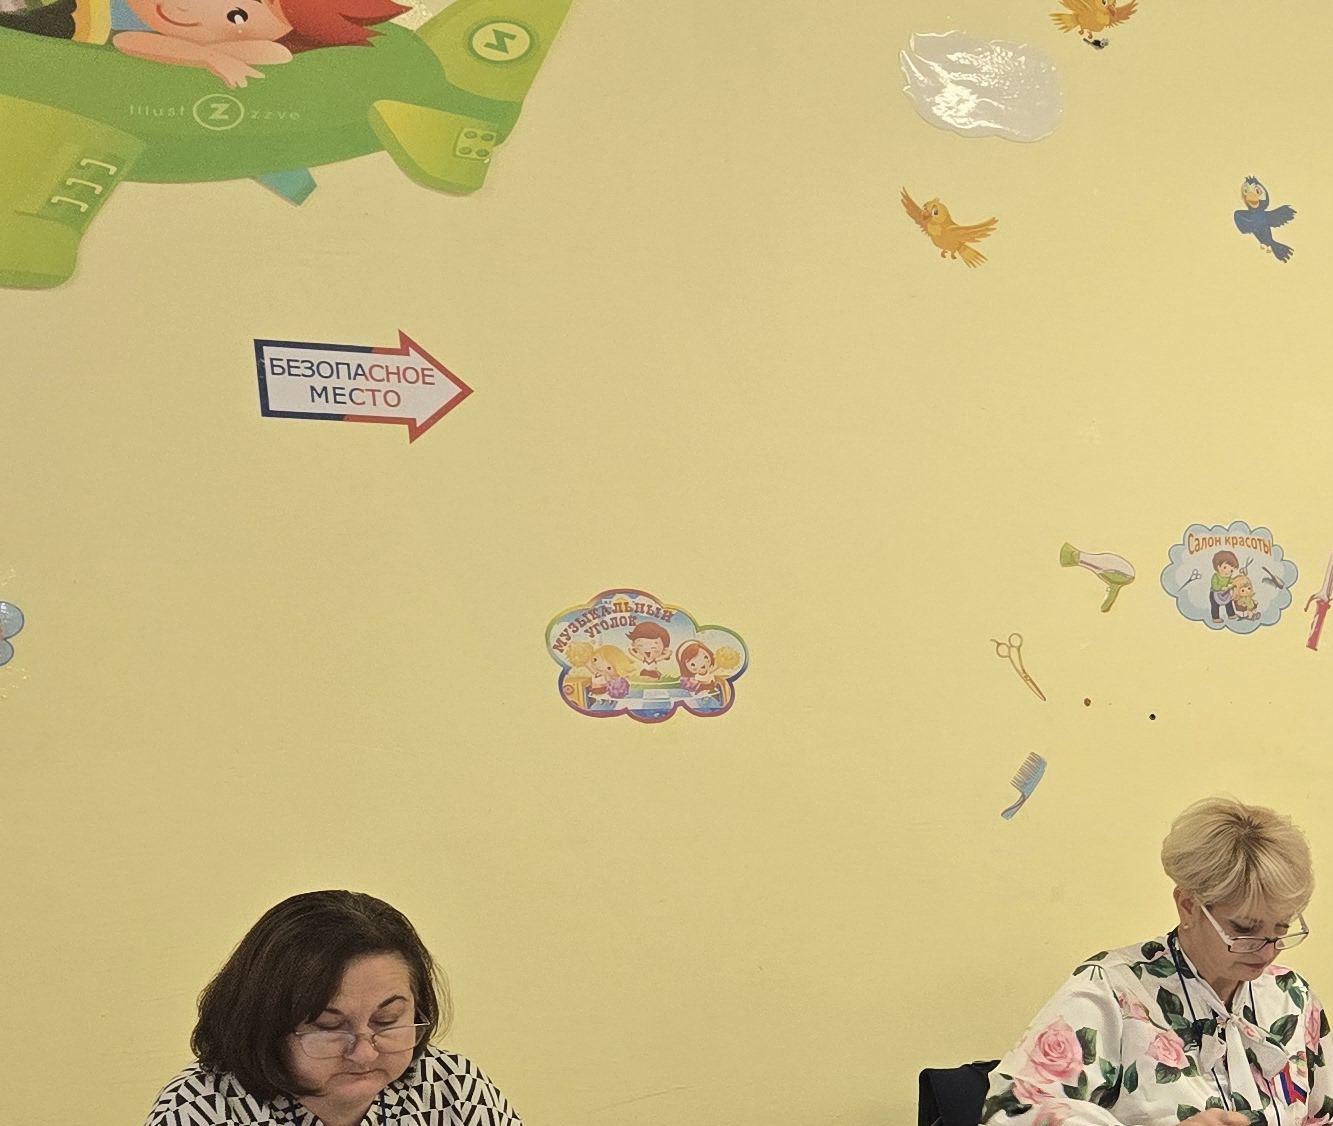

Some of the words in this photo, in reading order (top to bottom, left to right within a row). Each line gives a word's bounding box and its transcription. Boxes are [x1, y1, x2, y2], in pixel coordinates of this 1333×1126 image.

[269, 357, 436, 386] БЕЗОПАСНОЕ
[309, 385, 402, 408] МЕСТО
[1187, 533, 1222, 555] Салон
[1224, 535, 1272, 556] красоты
